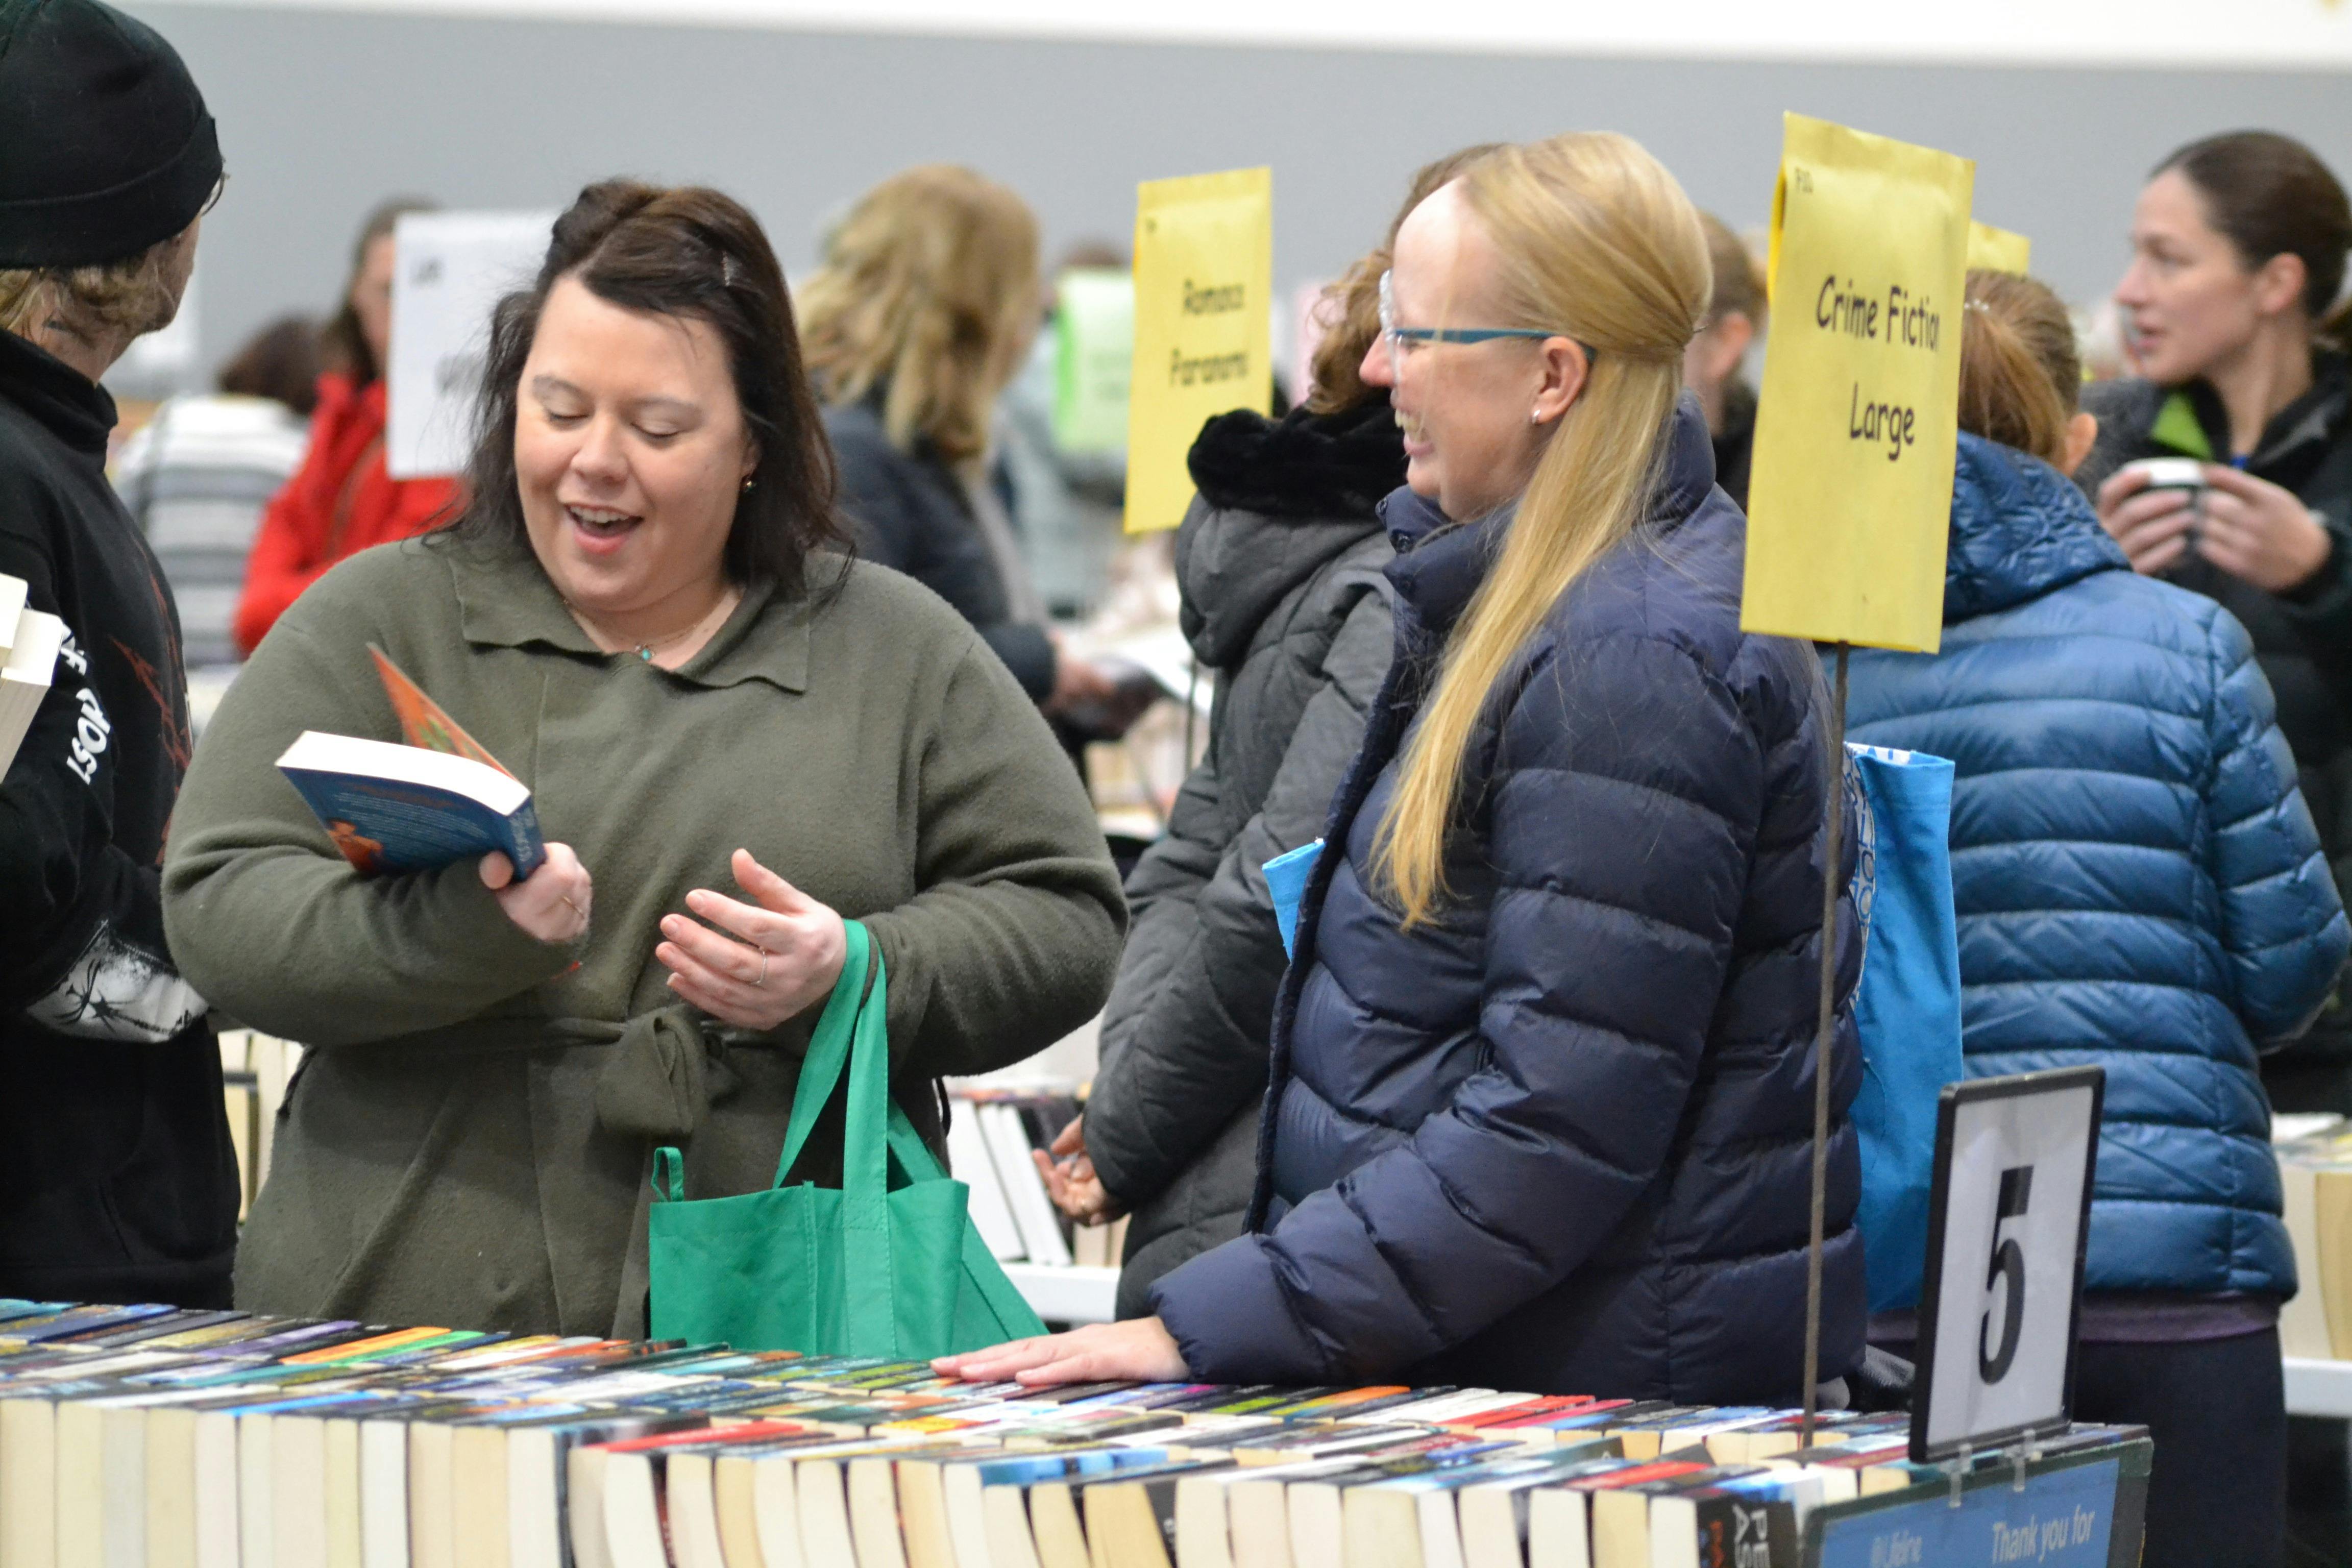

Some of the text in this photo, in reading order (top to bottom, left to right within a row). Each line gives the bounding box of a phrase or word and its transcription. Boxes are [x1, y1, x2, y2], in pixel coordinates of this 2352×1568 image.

[1816, 275, 1878, 339] Crime
[1849, 381, 1915, 461] Large
[1978, 1164, 2035, 1385] 5
[1992, 1503, 2096, 1565] Thank you for
